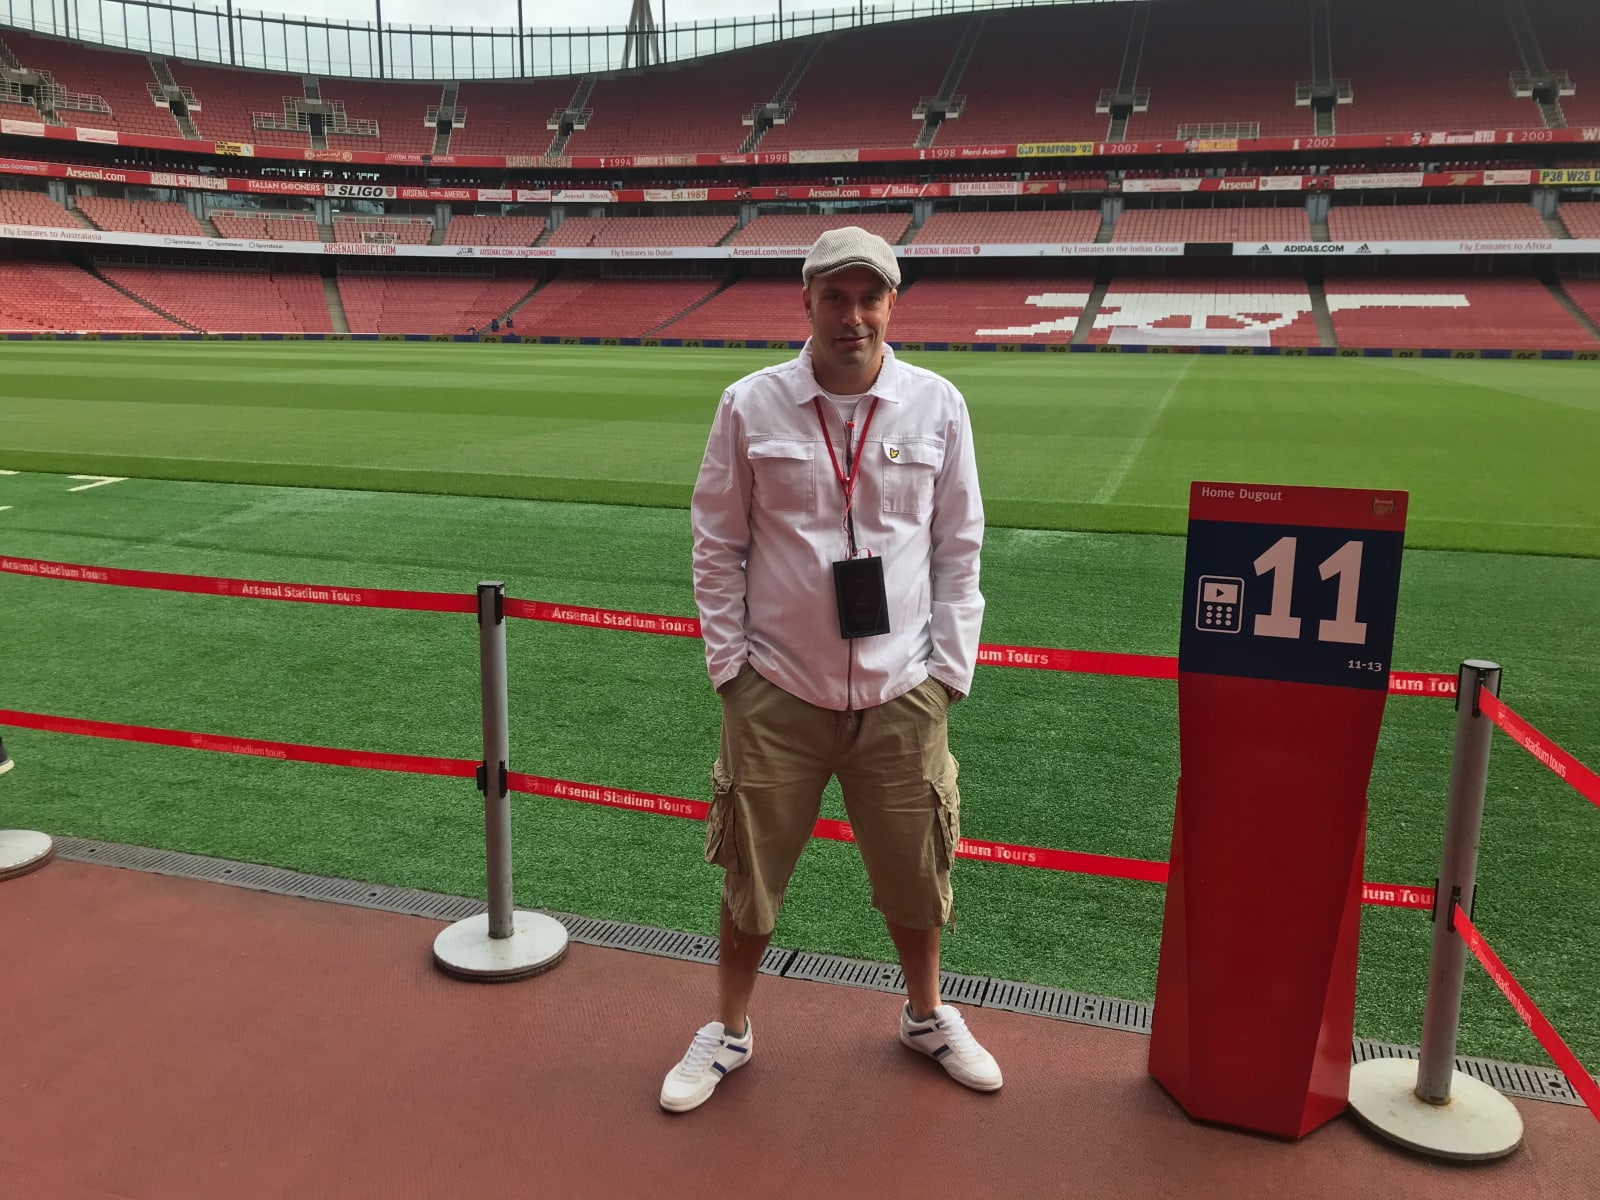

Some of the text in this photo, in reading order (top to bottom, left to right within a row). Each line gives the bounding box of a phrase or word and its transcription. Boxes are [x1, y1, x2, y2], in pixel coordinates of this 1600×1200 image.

[1521, 131, 1553, 141] 2003
[1111, 144, 1138, 153] 2002
[1306, 138, 1337, 148] 2002
[932, 149, 956, 158] 1998
[1035, 145, 1077, 154] TRAFFORD
[609, 157, 631, 167] 1994
[764, 153, 788, 163] 1998
[66, 167, 126, 182] Arsenal.com
[1542, 170, 1563, 182] P38
[1567, 170, 1591, 181] W26
[152, 172, 227, 190] ARSENAL PHILADELPHIA
[249, 180, 279, 190] ITALIAN
[281, 182, 321, 192] GOONERS
[1218, 179, 1257, 191] Arsenal
[338, 186, 384, 197] SLIGO
[402, 189, 430, 198] ARSENAL
[444, 190, 470, 199] AMERICA
[687, 191, 707, 199] 1985
[808, 188, 860, 198] Arsenal.com
[3, 227, 15, 237] Fly
[17, 228, 48, 237] Emirates
[60, 231, 102, 240] Australasia
[324, 243, 396, 255] ARSENALDIRECT.COM
[611, 249, 620, 257] Fly
[621, 249, 646, 257] Emirates
[904, 246, 971, 255] MY ARSENAL REWARDS
[1061, 246, 1072, 254] Fly
[1074, 245, 1105, 253] Emirates
[1116, 245, 1128, 253] the
[1130, 244, 1153, 253] Indian
[1154, 245, 1179, 253] Ocean
[1283, 245, 1344, 253] ADIDAS.COM
[1459, 242, 1473, 252] Fly
[1475, 242, 1512, 251] Emirates
[1524, 242, 1552, 250] Africa
[1201, 487, 1282, 503] Home Dugout
[2, 559, 108, 581] Arsenal Stadium Tours
[242, 583, 362, 602] Arsenal Stadium Tours
[1253, 536, 1367, 645] 11
[552, 607, 695, 633] Arsenal Stadium Tours
[1006, 649, 1049, 665] Tours
[1348, 660, 1383, 672] 11-13
[1428, 677, 1456, 693] Tou
[232, 744, 265, 756] stadium
[265, 748, 287, 759] tours
[1524, 737, 1566, 778] stadium tours
[554, 782, 693, 814] Arsenal Stadium Tours
[956, 840, 1036, 862] dium Tours
[1400, 889, 1432, 904] Tou
